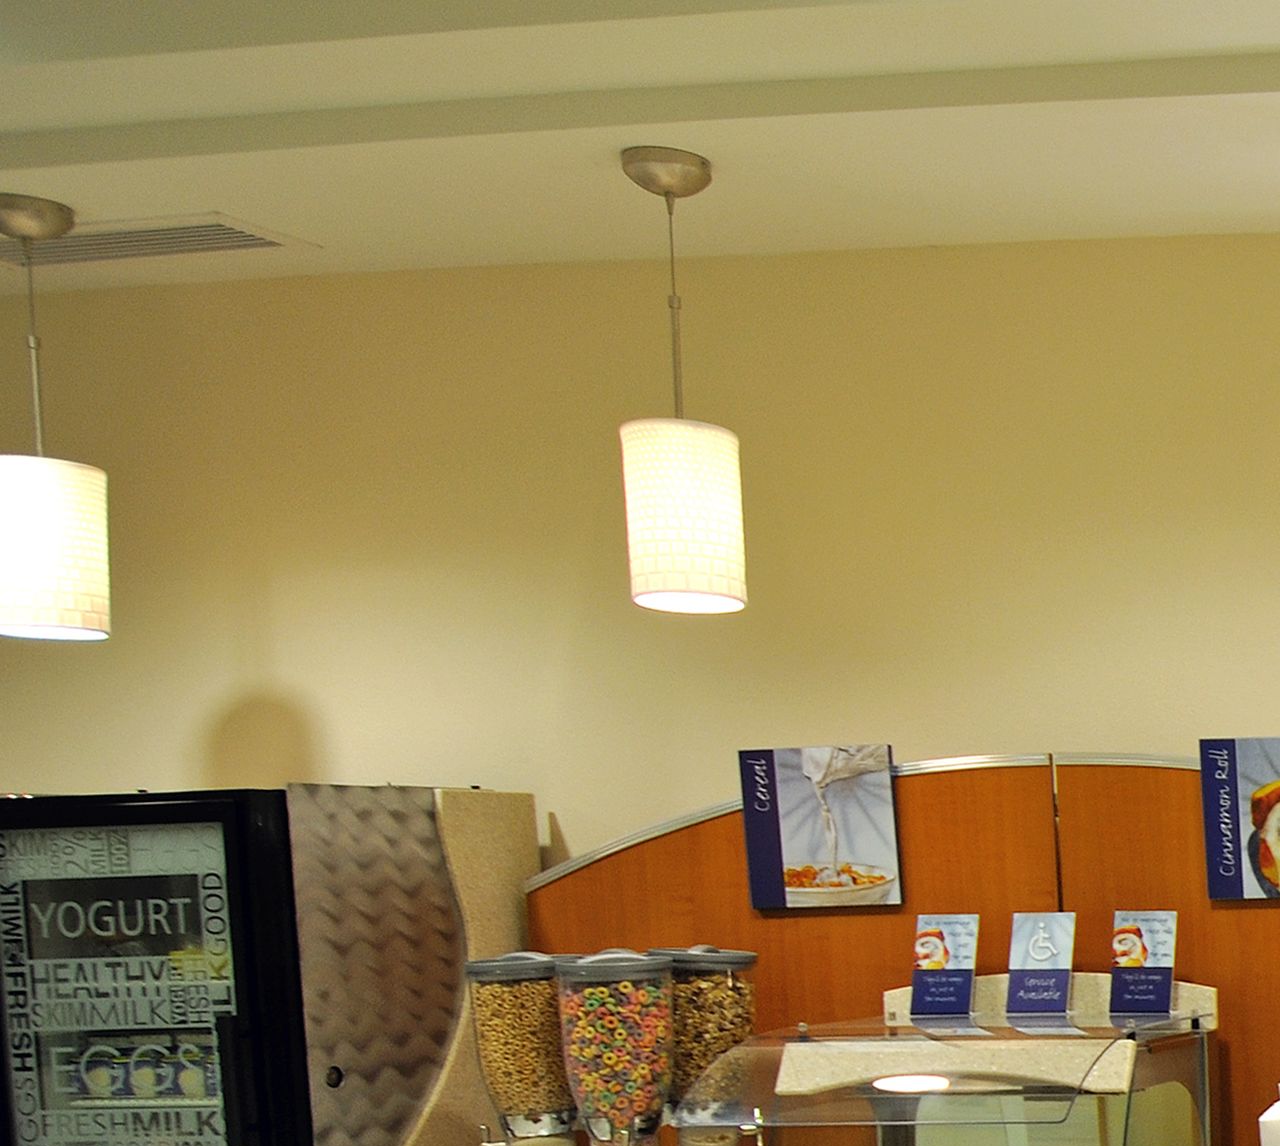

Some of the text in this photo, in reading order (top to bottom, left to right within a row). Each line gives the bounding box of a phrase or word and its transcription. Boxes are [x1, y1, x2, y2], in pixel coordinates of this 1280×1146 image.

[747, 758, 771, 812] Cereal
[1208, 748, 1235, 877] Cinnamon Roll
[90, 829, 108, 876] MILK
[0, 882, 22, 942] MILK
[30, 898, 192, 939] YOGURT
[201, 872, 228, 956] GOOD
[30, 960, 166, 999] HEALTHY
[5, 971, 34, 1072] FRESH
[52, 1044, 203, 1097] EGGS
[131, 1111, 222, 1137] MILK
